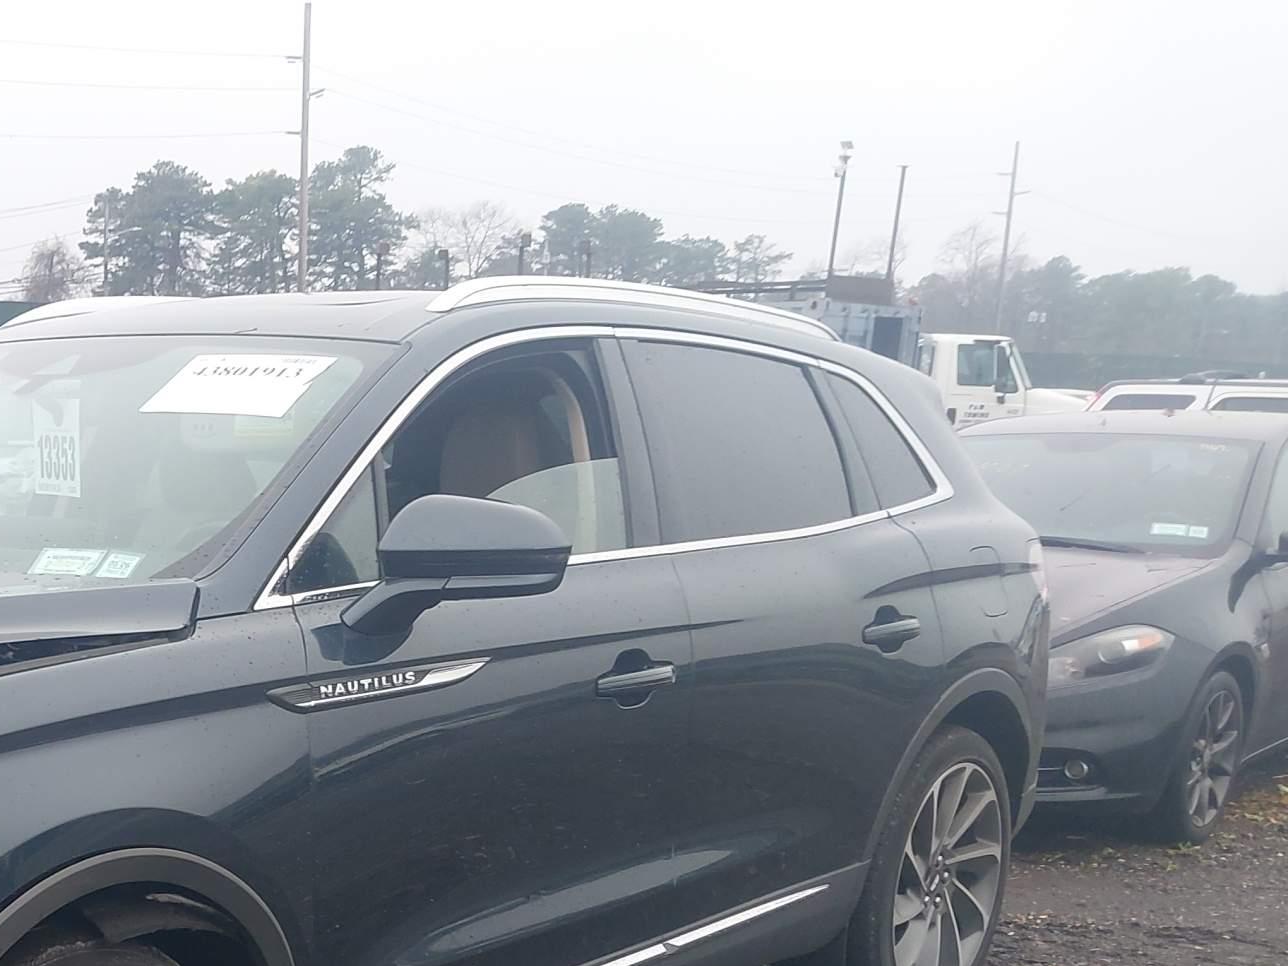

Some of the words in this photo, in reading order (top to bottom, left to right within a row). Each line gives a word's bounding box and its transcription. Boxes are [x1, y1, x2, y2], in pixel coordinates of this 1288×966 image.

[192, 366, 304, 378] 43801913
[38, 434, 75, 481] 13353
[319, 671, 416, 698] NAUTILUS
